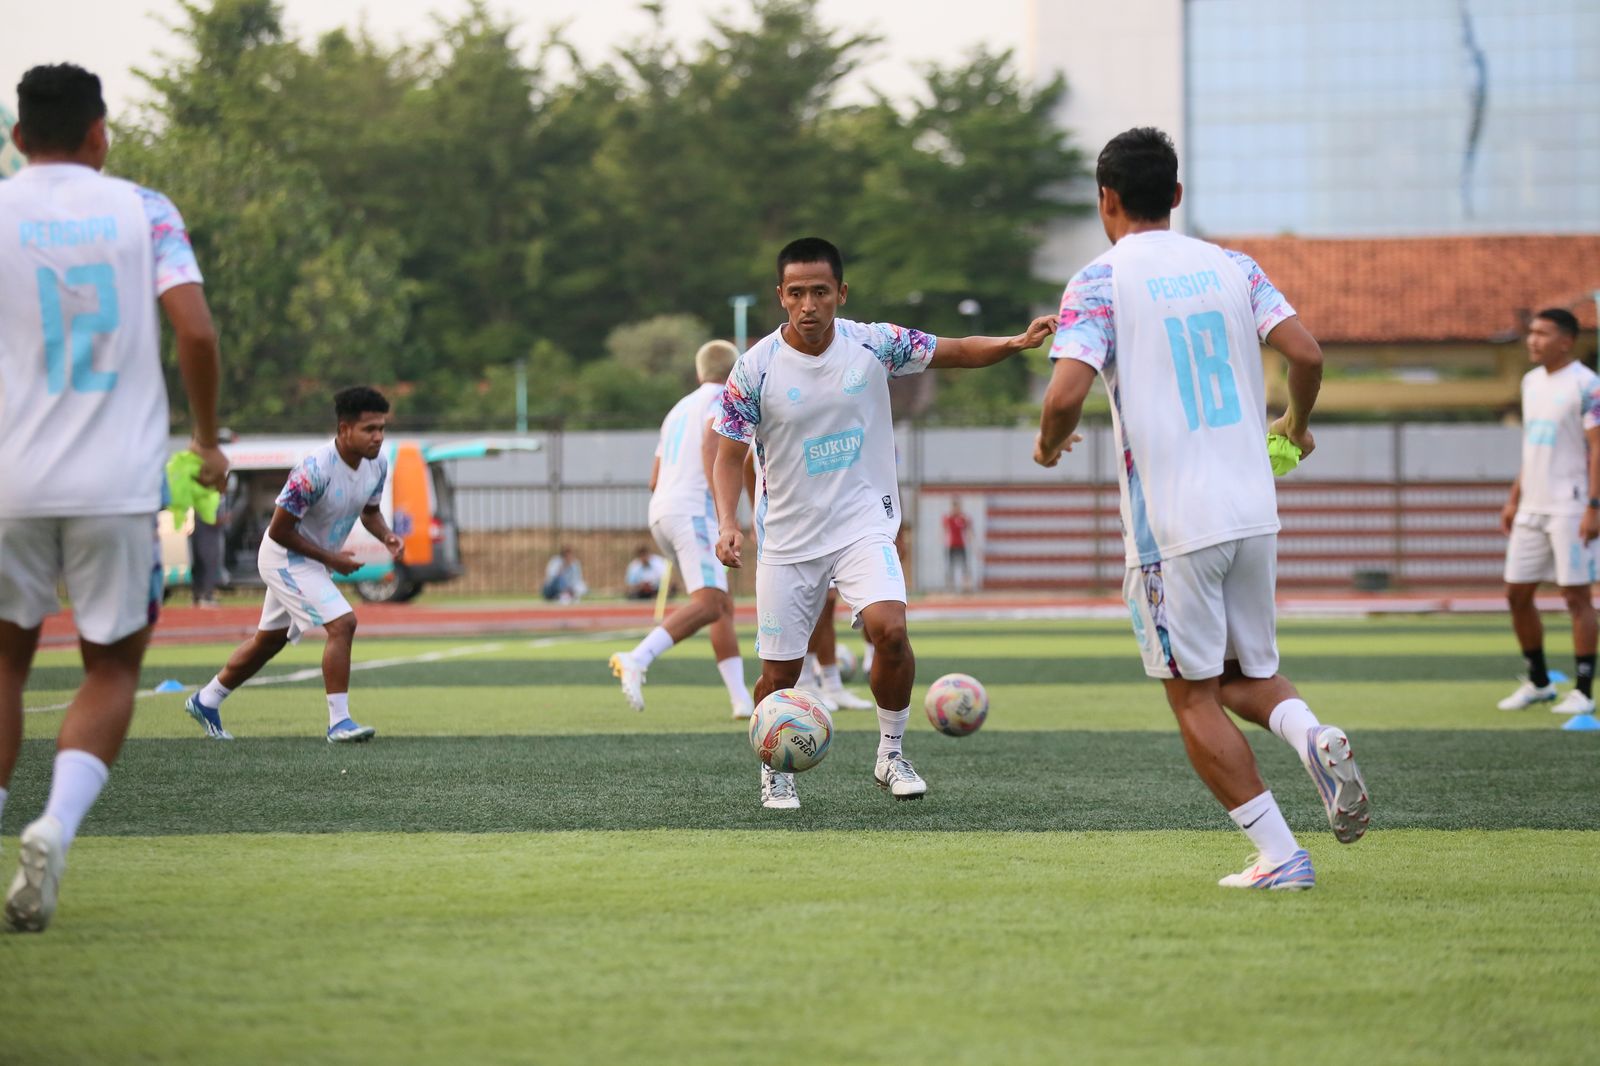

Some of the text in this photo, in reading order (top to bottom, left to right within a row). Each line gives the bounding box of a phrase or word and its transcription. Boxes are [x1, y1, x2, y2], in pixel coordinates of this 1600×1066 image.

[36, 263, 119, 395] 12
[1164, 310, 1242, 432] 18
[809, 435, 860, 460] SUKUN
[790, 735, 816, 757] SPECS
